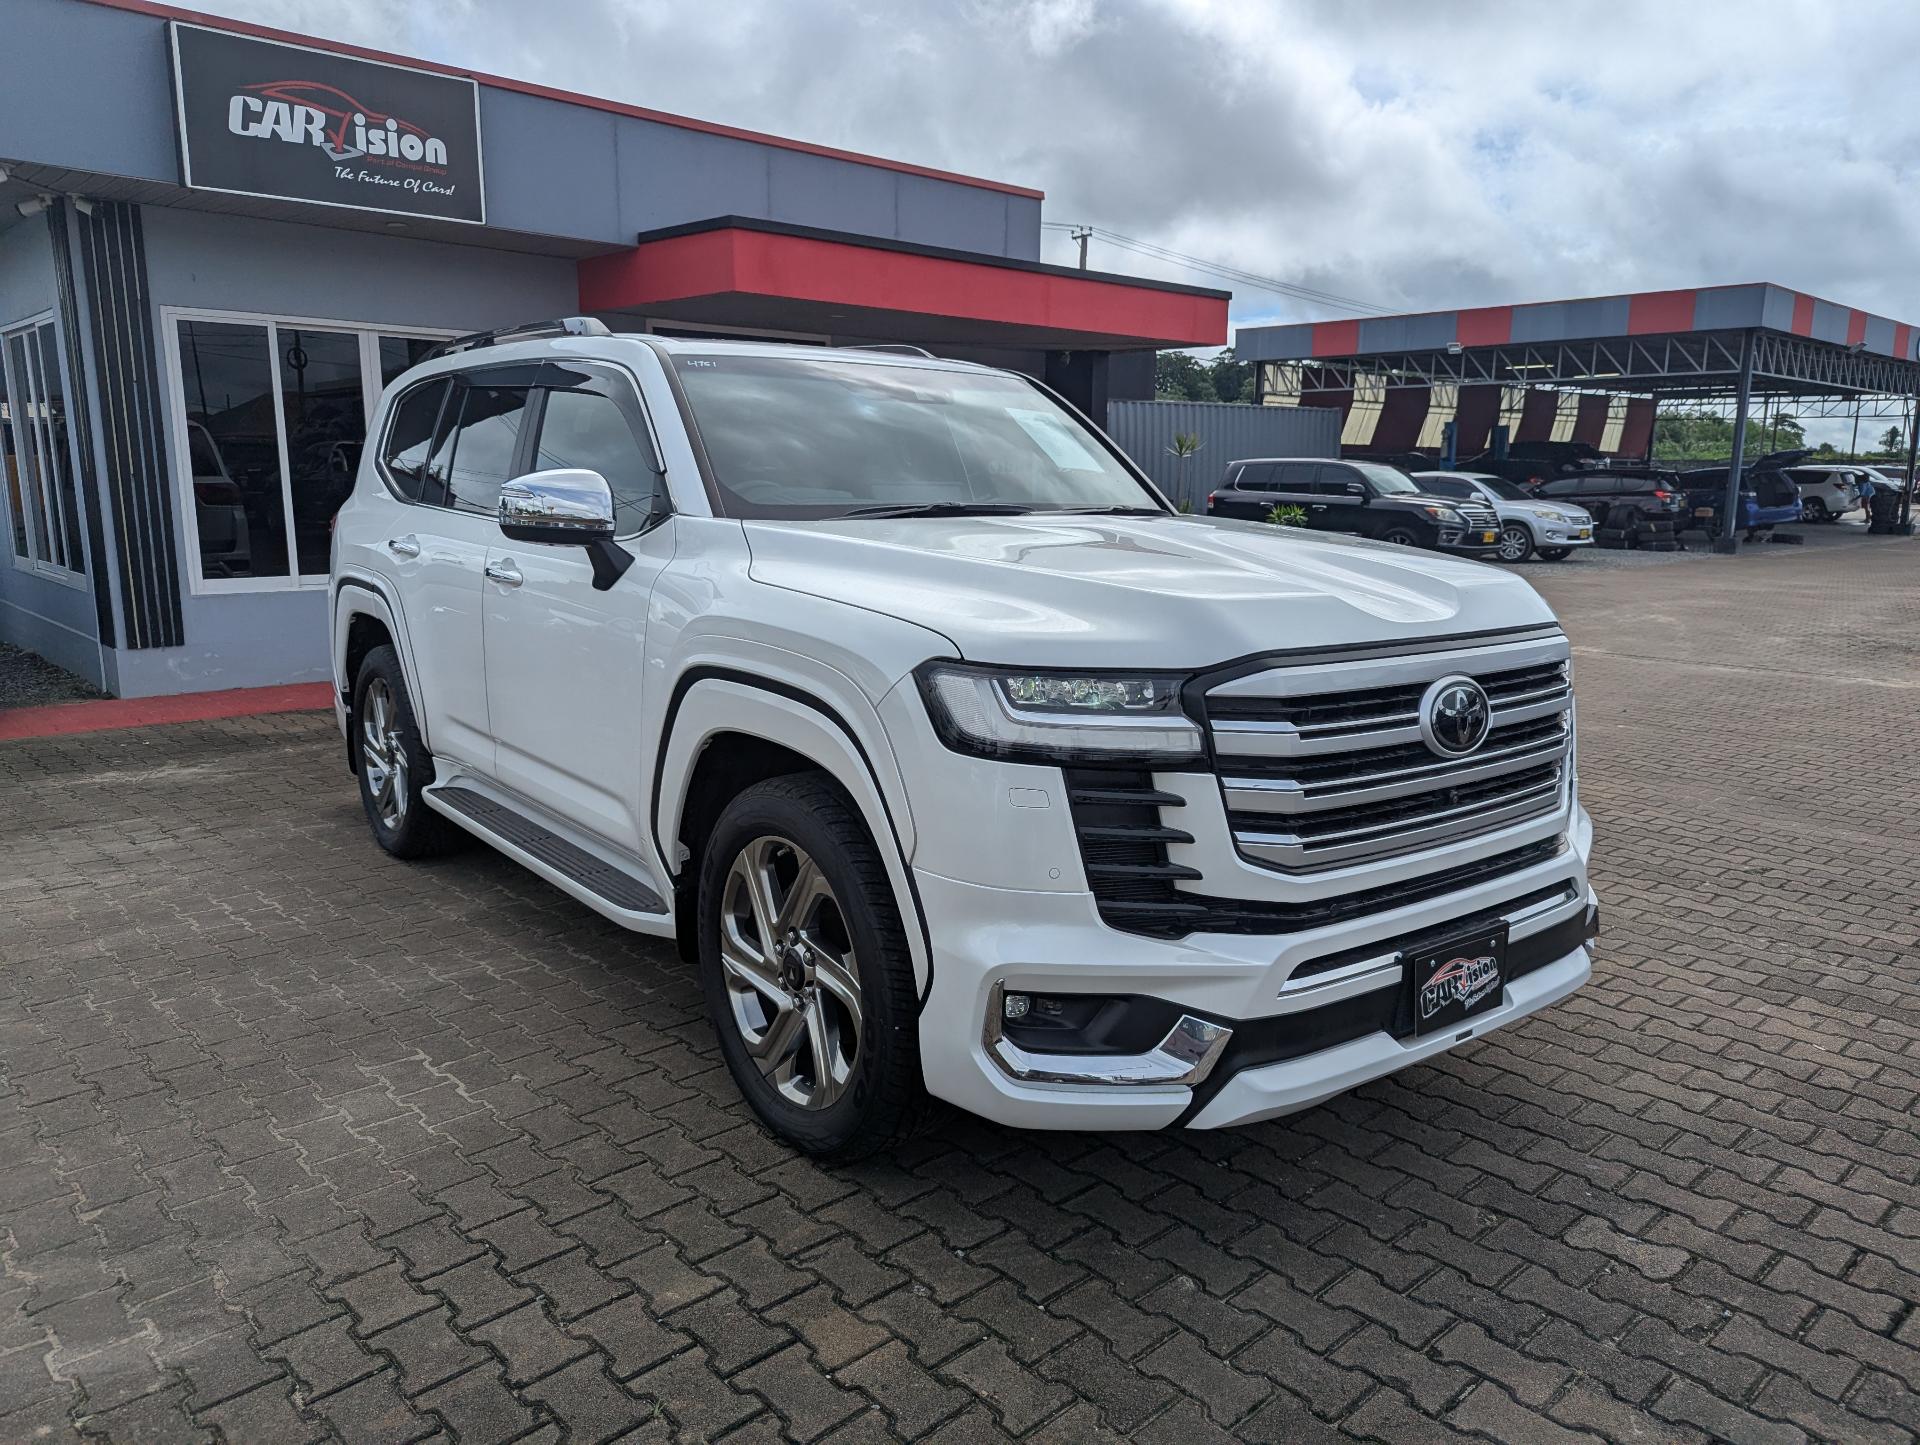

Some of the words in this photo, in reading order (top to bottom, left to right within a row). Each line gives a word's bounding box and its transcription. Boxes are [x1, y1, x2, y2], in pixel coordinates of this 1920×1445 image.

[334, 166, 354, 179] The
[358, 170, 401, 187] Future
[403, 178, 421, 194] Of
[422, 181, 456, 196] Cars!
